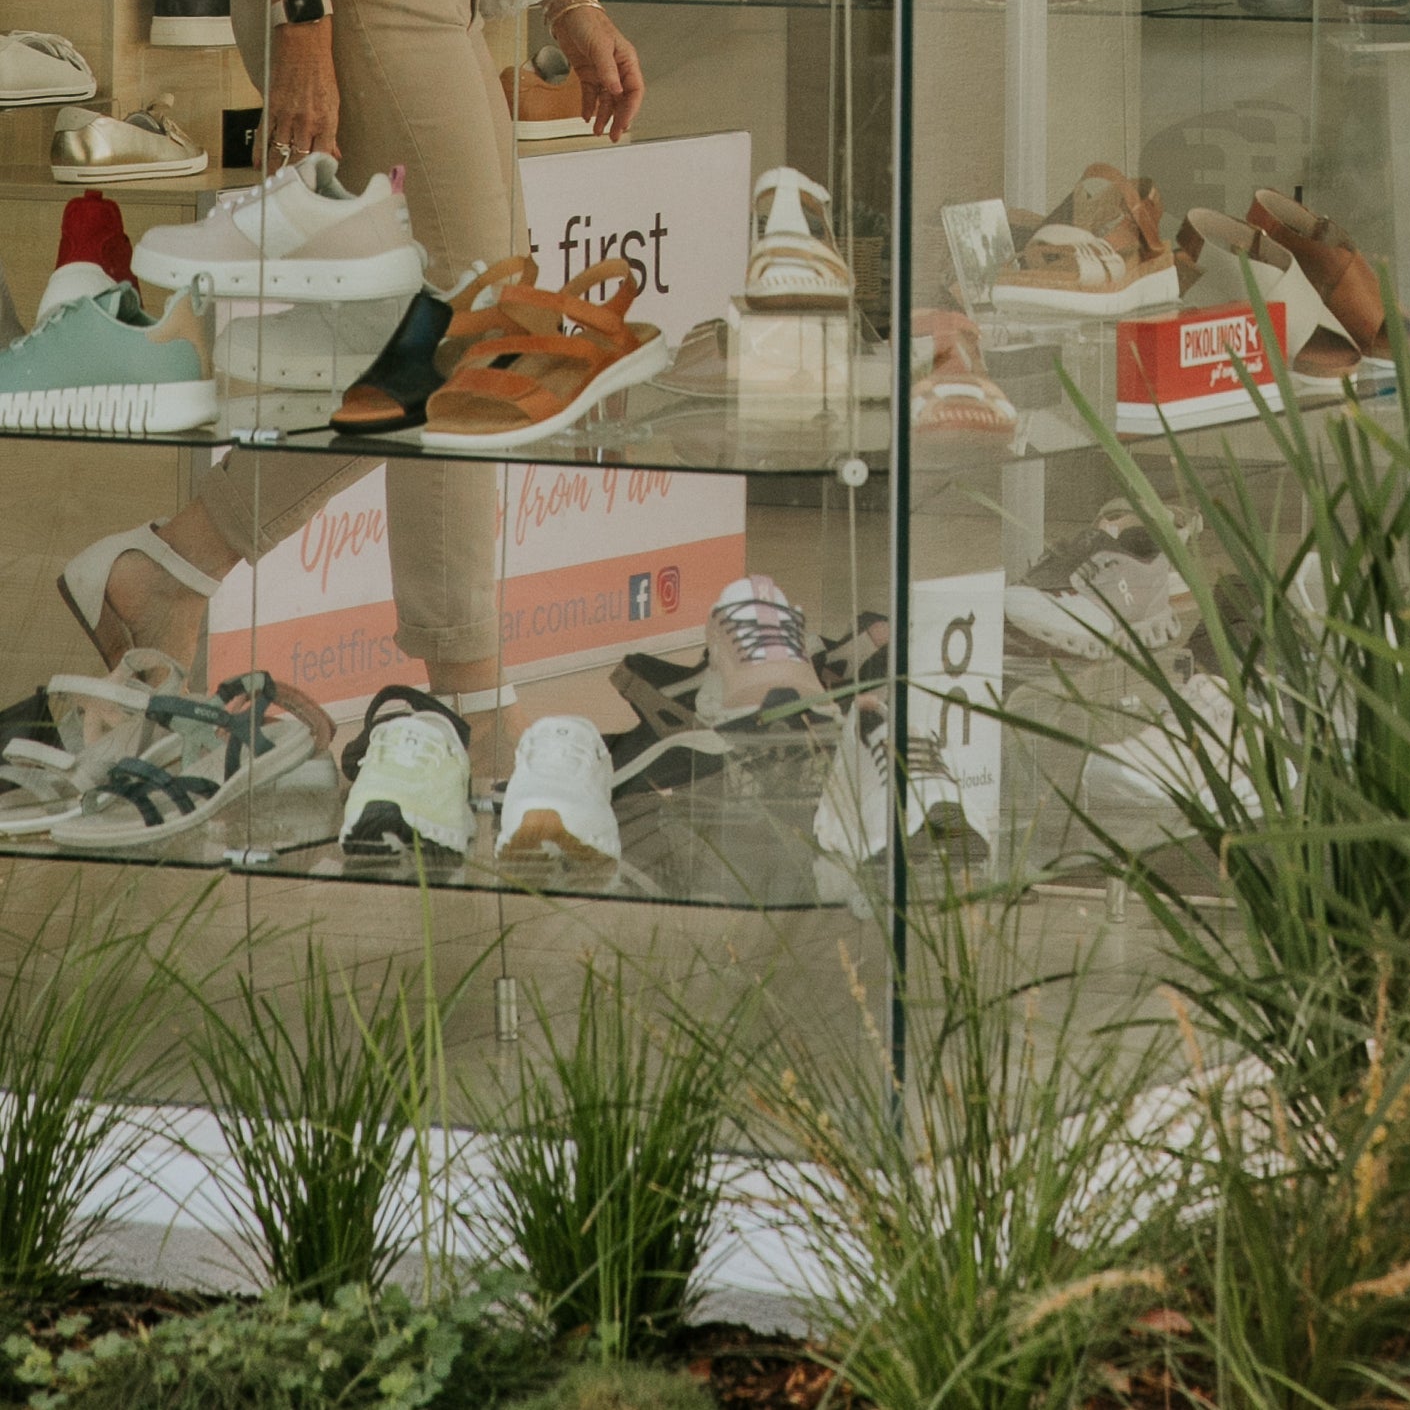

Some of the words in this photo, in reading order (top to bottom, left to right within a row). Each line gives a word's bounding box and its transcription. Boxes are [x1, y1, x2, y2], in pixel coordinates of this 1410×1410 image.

[559, 212, 669, 302] first
[301, 506, 386, 595] Open
[515, 463, 592, 546] from
